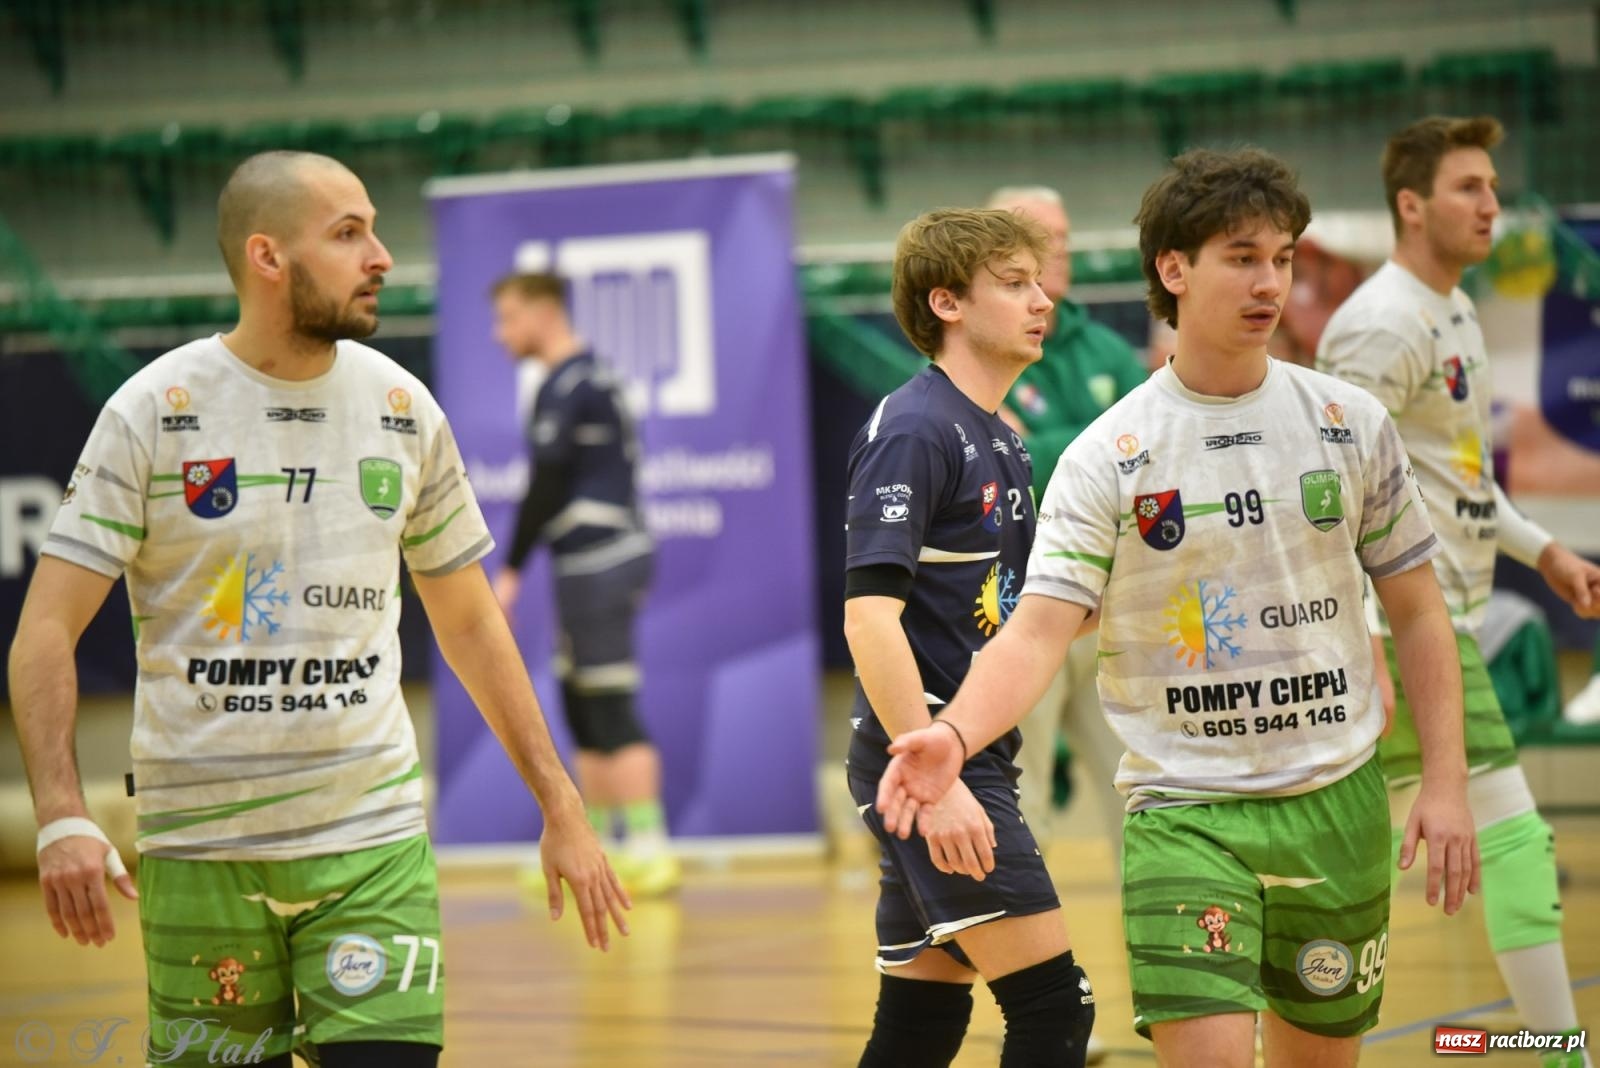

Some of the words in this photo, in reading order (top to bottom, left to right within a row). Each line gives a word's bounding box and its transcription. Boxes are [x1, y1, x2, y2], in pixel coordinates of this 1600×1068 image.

[281, 467, 317, 503] 77
[1225, 489, 1264, 527] 99
[1260, 597, 1339, 629] GUARD
[187, 657, 297, 686] POMPY
[223, 695, 273, 713] 605
[280, 693, 328, 712] 944
[1166, 680, 1263, 714] POMPY
[1203, 718, 1247, 738] 605
[1254, 712, 1299, 735] 944
[1305, 704, 1347, 727] 146
[392, 934, 440, 995] 77
[1301, 957, 1345, 981] Jura
[1356, 931, 1388, 995] 99
